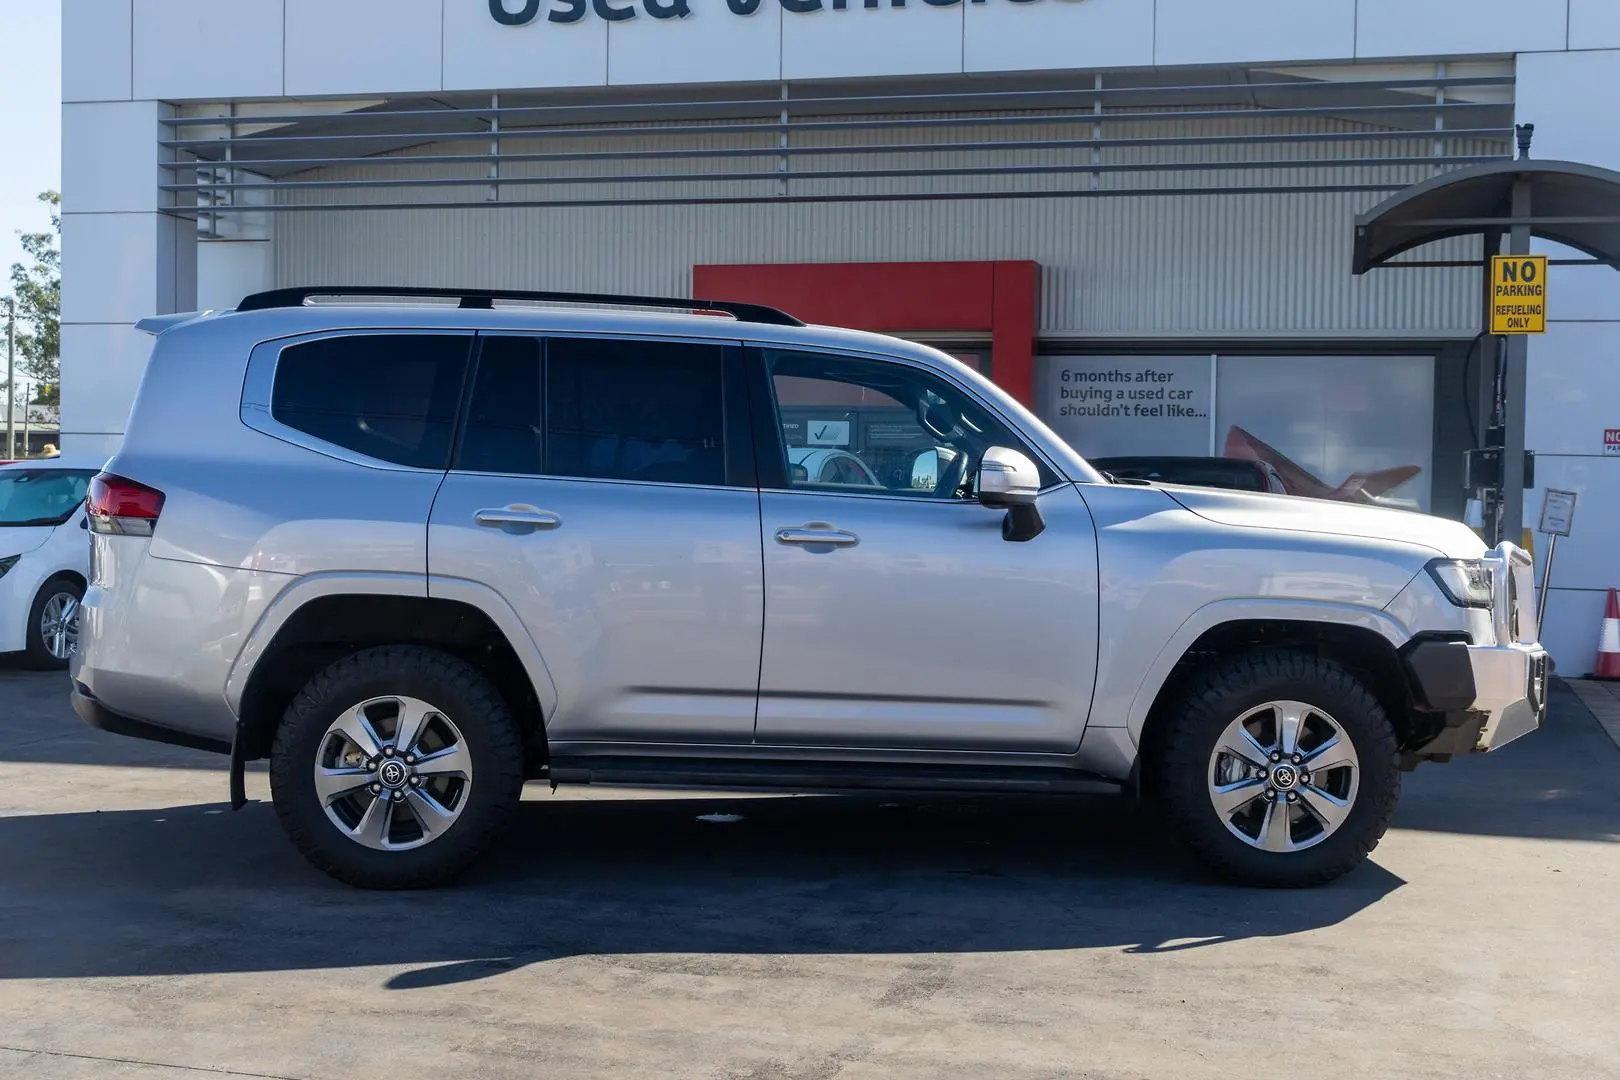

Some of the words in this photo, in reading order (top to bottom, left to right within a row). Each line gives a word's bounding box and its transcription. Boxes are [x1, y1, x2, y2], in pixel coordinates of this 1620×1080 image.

[1502, 261, 1536, 282] NO
[1496, 285, 1542, 296] PARKING
[1496, 305, 1541, 315] REFUELING
[1507, 318, 1530, 328] ONLY
[1061, 369, 1070, 382] 6
[1074, 369, 1132, 382] months
[1135, 369, 1174, 382] after
[1060, 387, 1113, 402] buying
[1116, 390, 1125, 400] a
[1128, 387, 1164, 400] used
[1168, 390, 1193, 400] car
[1060, 404, 1130, 417] shouldn't
[1133, 404, 1163, 417] feel
[1167, 404, 1207, 417] like...
